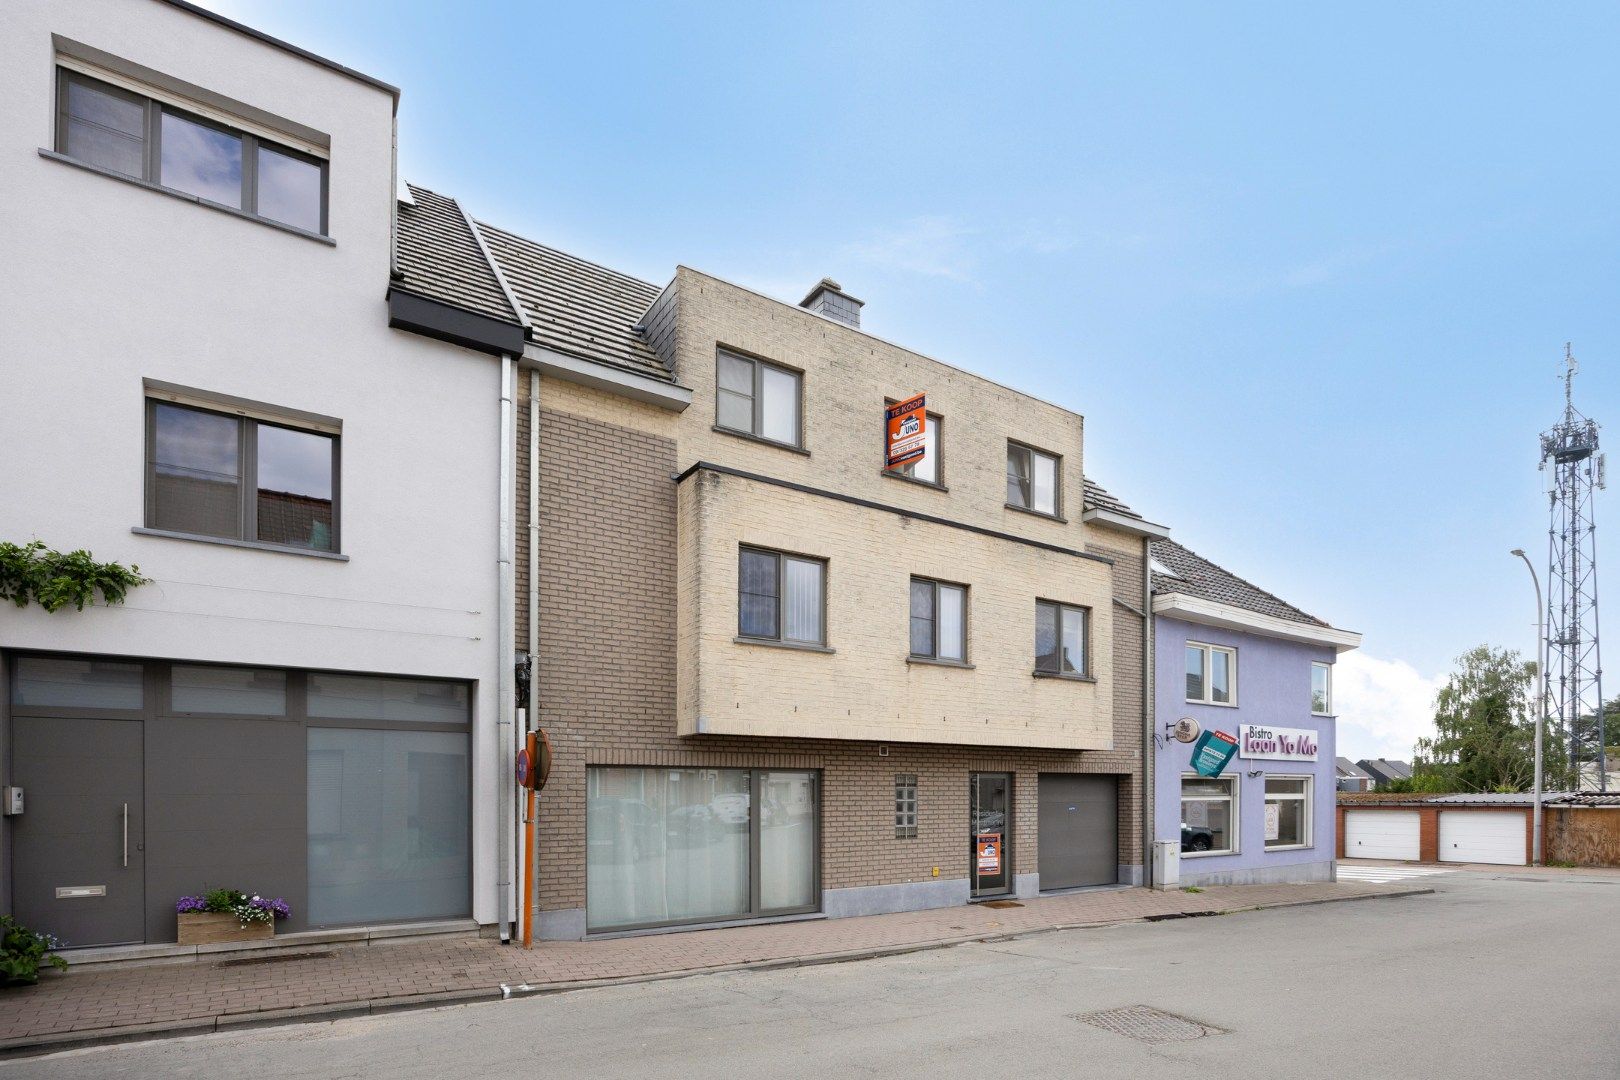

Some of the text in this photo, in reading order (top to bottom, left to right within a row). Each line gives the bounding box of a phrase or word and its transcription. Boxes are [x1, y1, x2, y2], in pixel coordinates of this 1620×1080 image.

[891, 399, 923, 418] TE KOOP
[1249, 725, 1273, 740] Bistro
